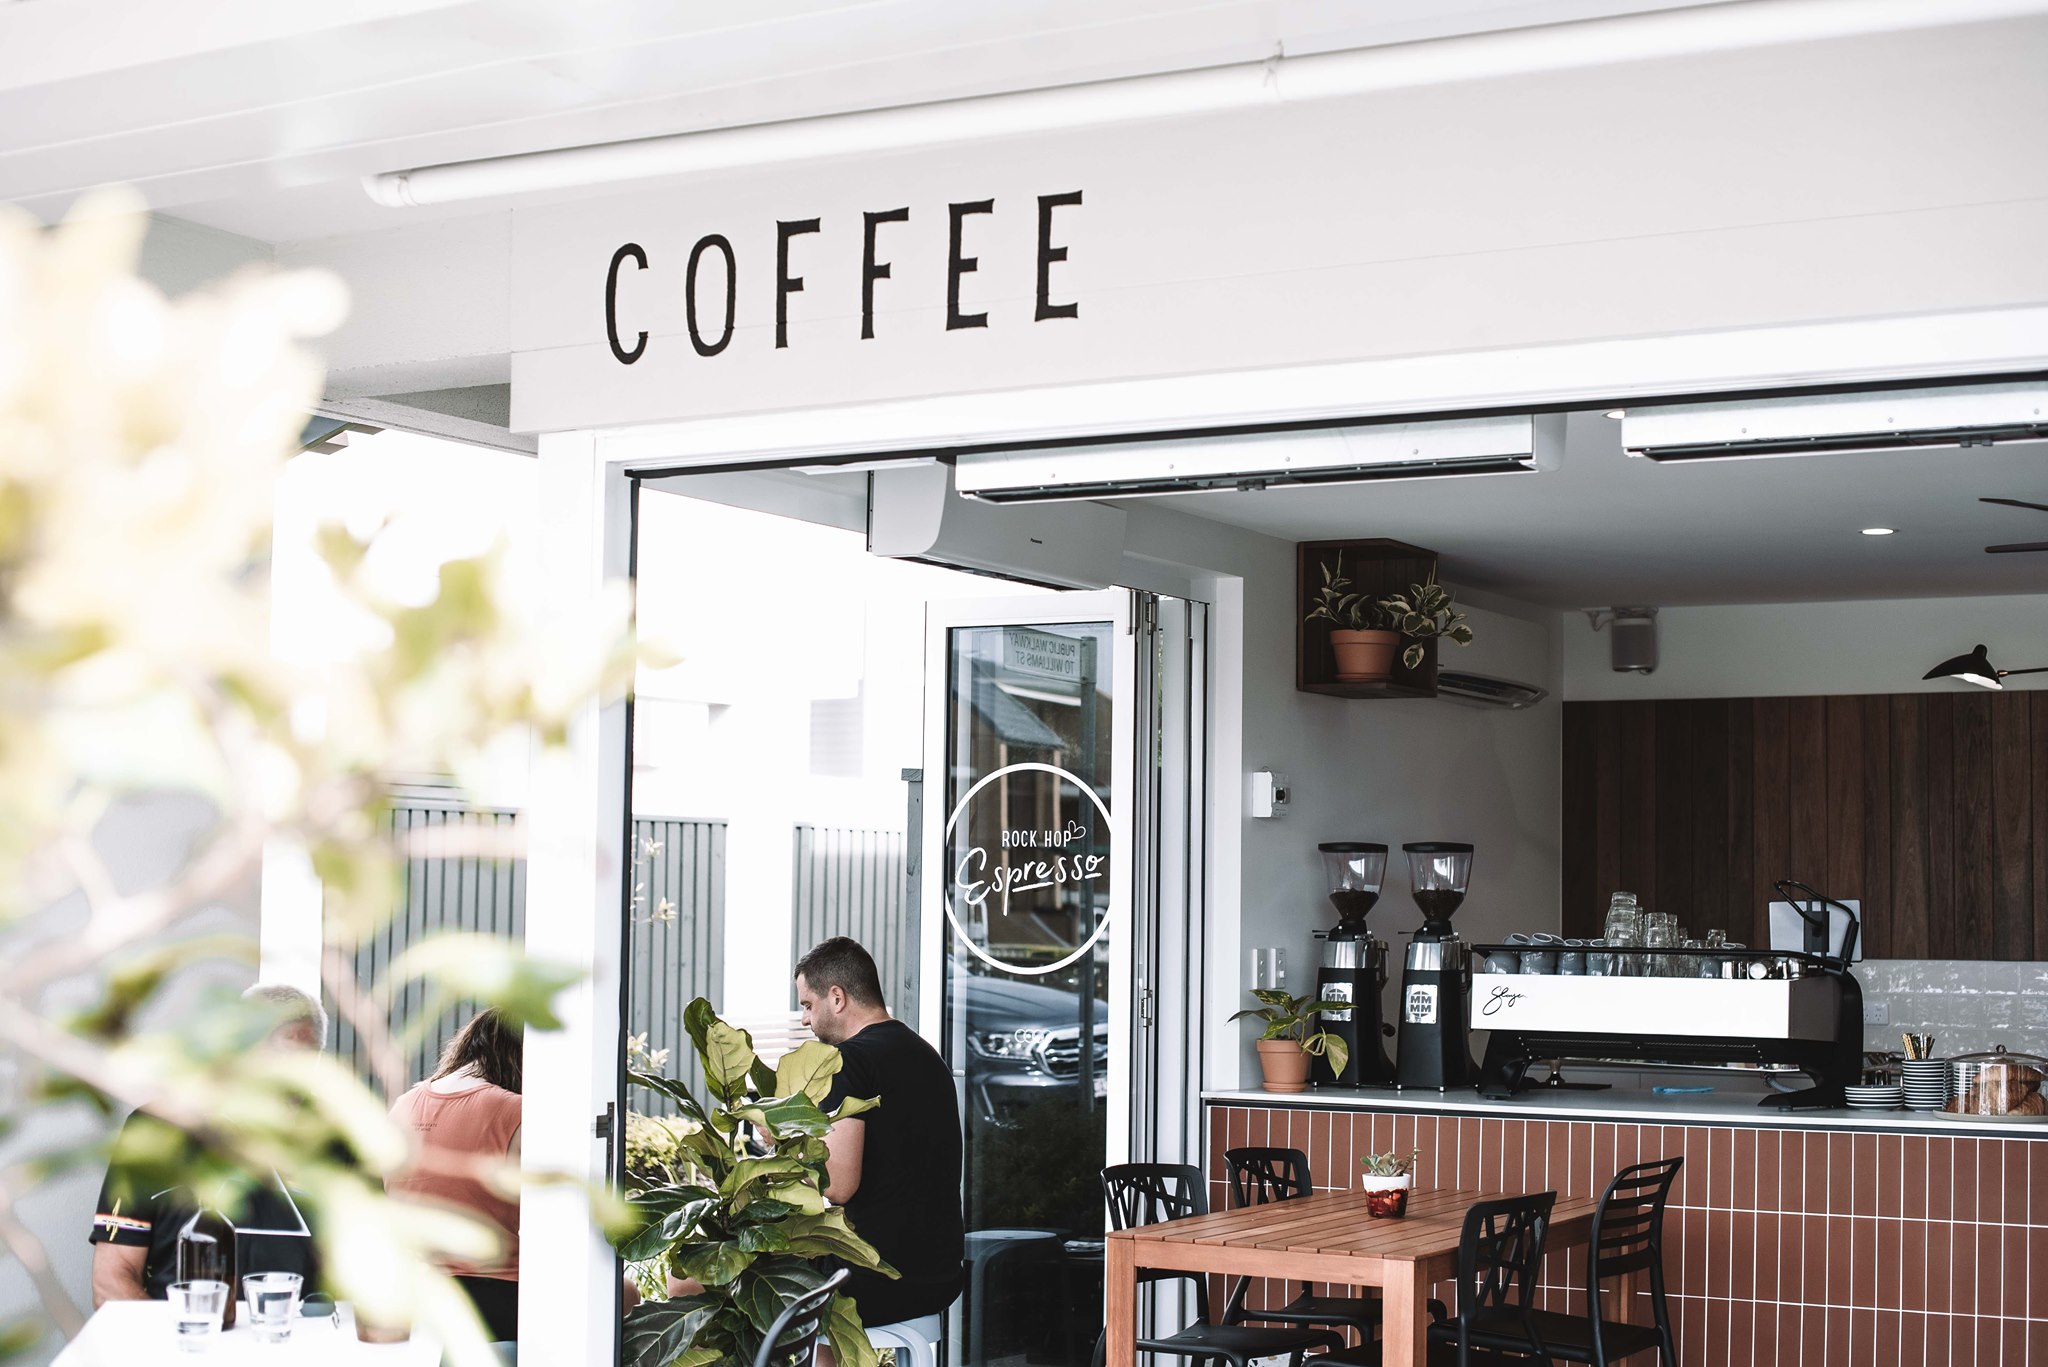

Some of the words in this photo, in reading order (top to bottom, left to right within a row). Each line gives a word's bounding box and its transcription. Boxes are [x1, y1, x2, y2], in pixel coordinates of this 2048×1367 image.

[606, 190, 1083, 365] COFFEE
[1002, 830, 1038, 848] ROCK
[1044, 830, 1072, 848] HOP
[955, 847, 1105, 917] Espresso
